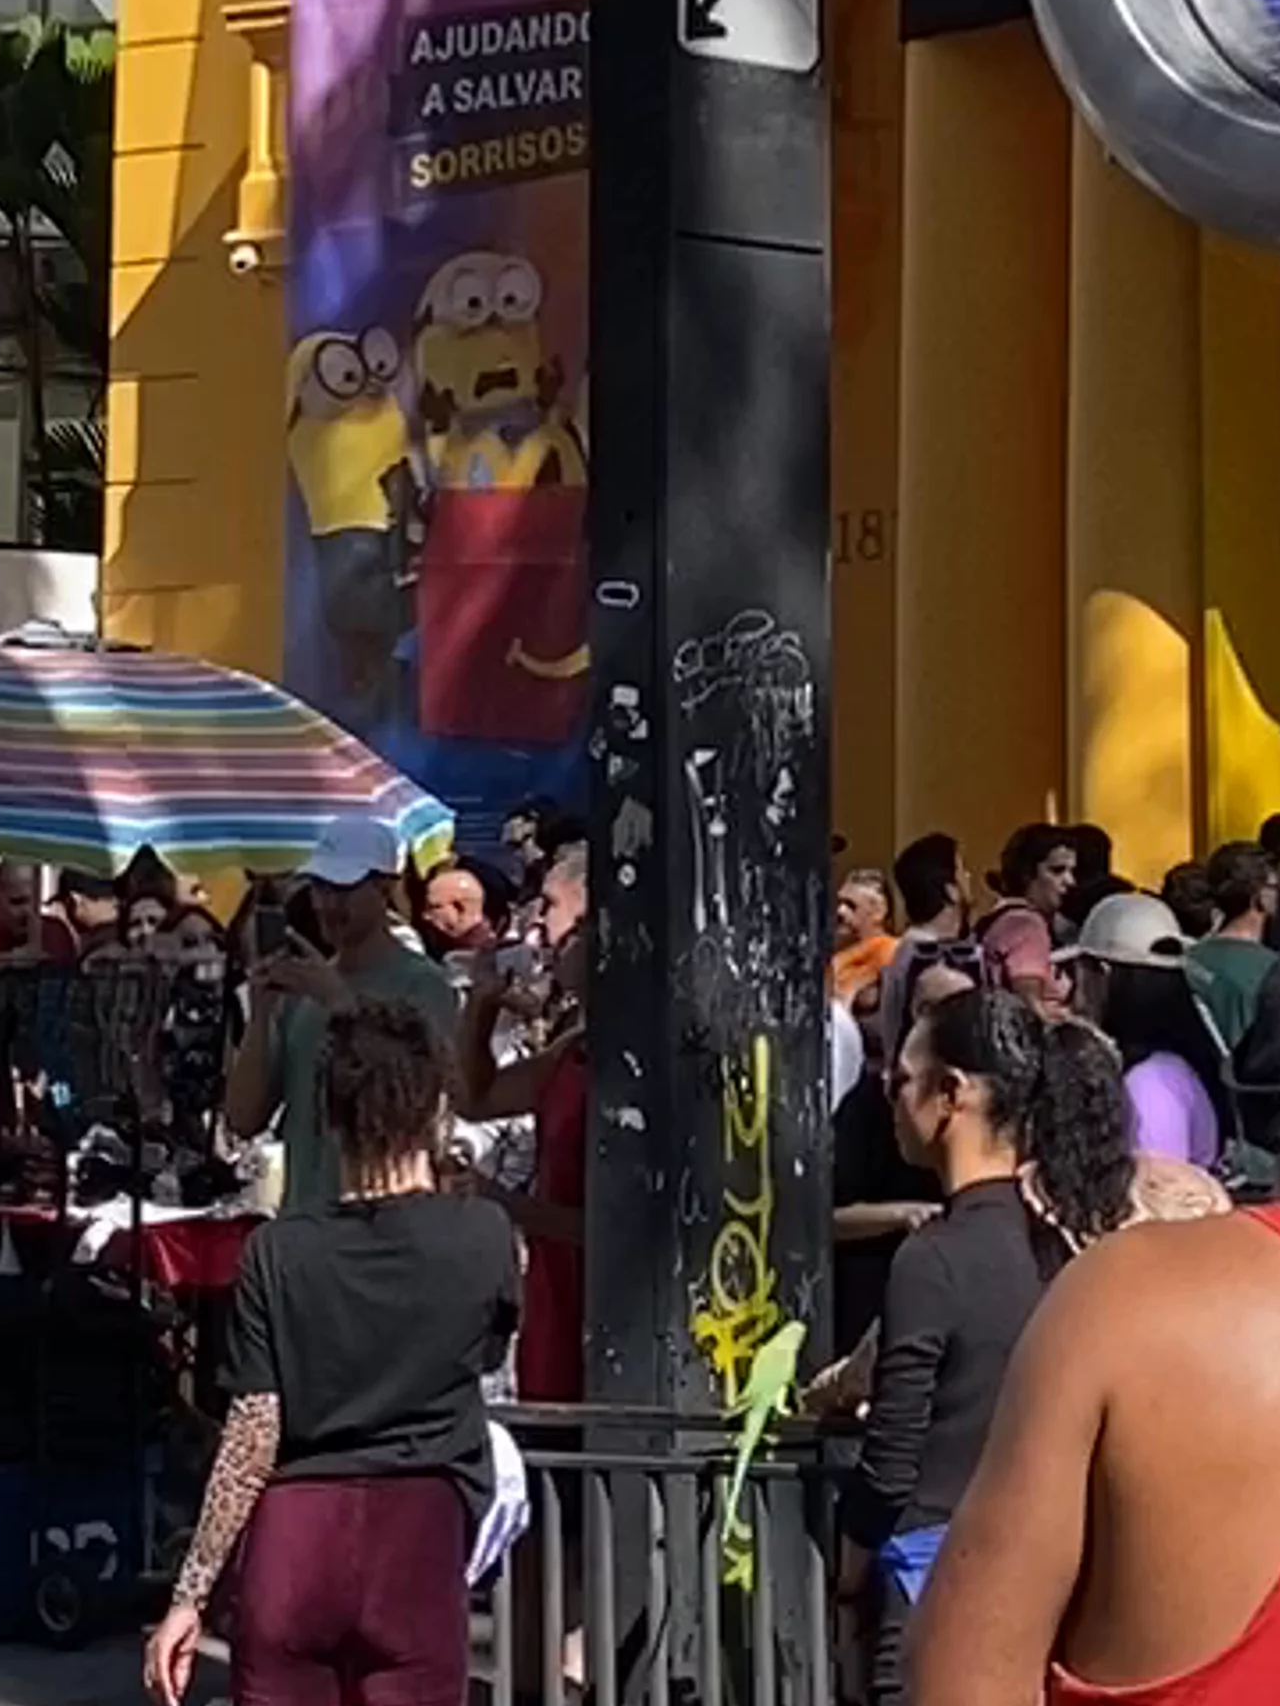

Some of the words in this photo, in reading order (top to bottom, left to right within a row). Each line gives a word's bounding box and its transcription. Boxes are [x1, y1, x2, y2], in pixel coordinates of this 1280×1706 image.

[422, 82, 446, 117] A
[453, 65, 583, 113] SALVAR
[410, 123, 587, 188] SORRISOS
